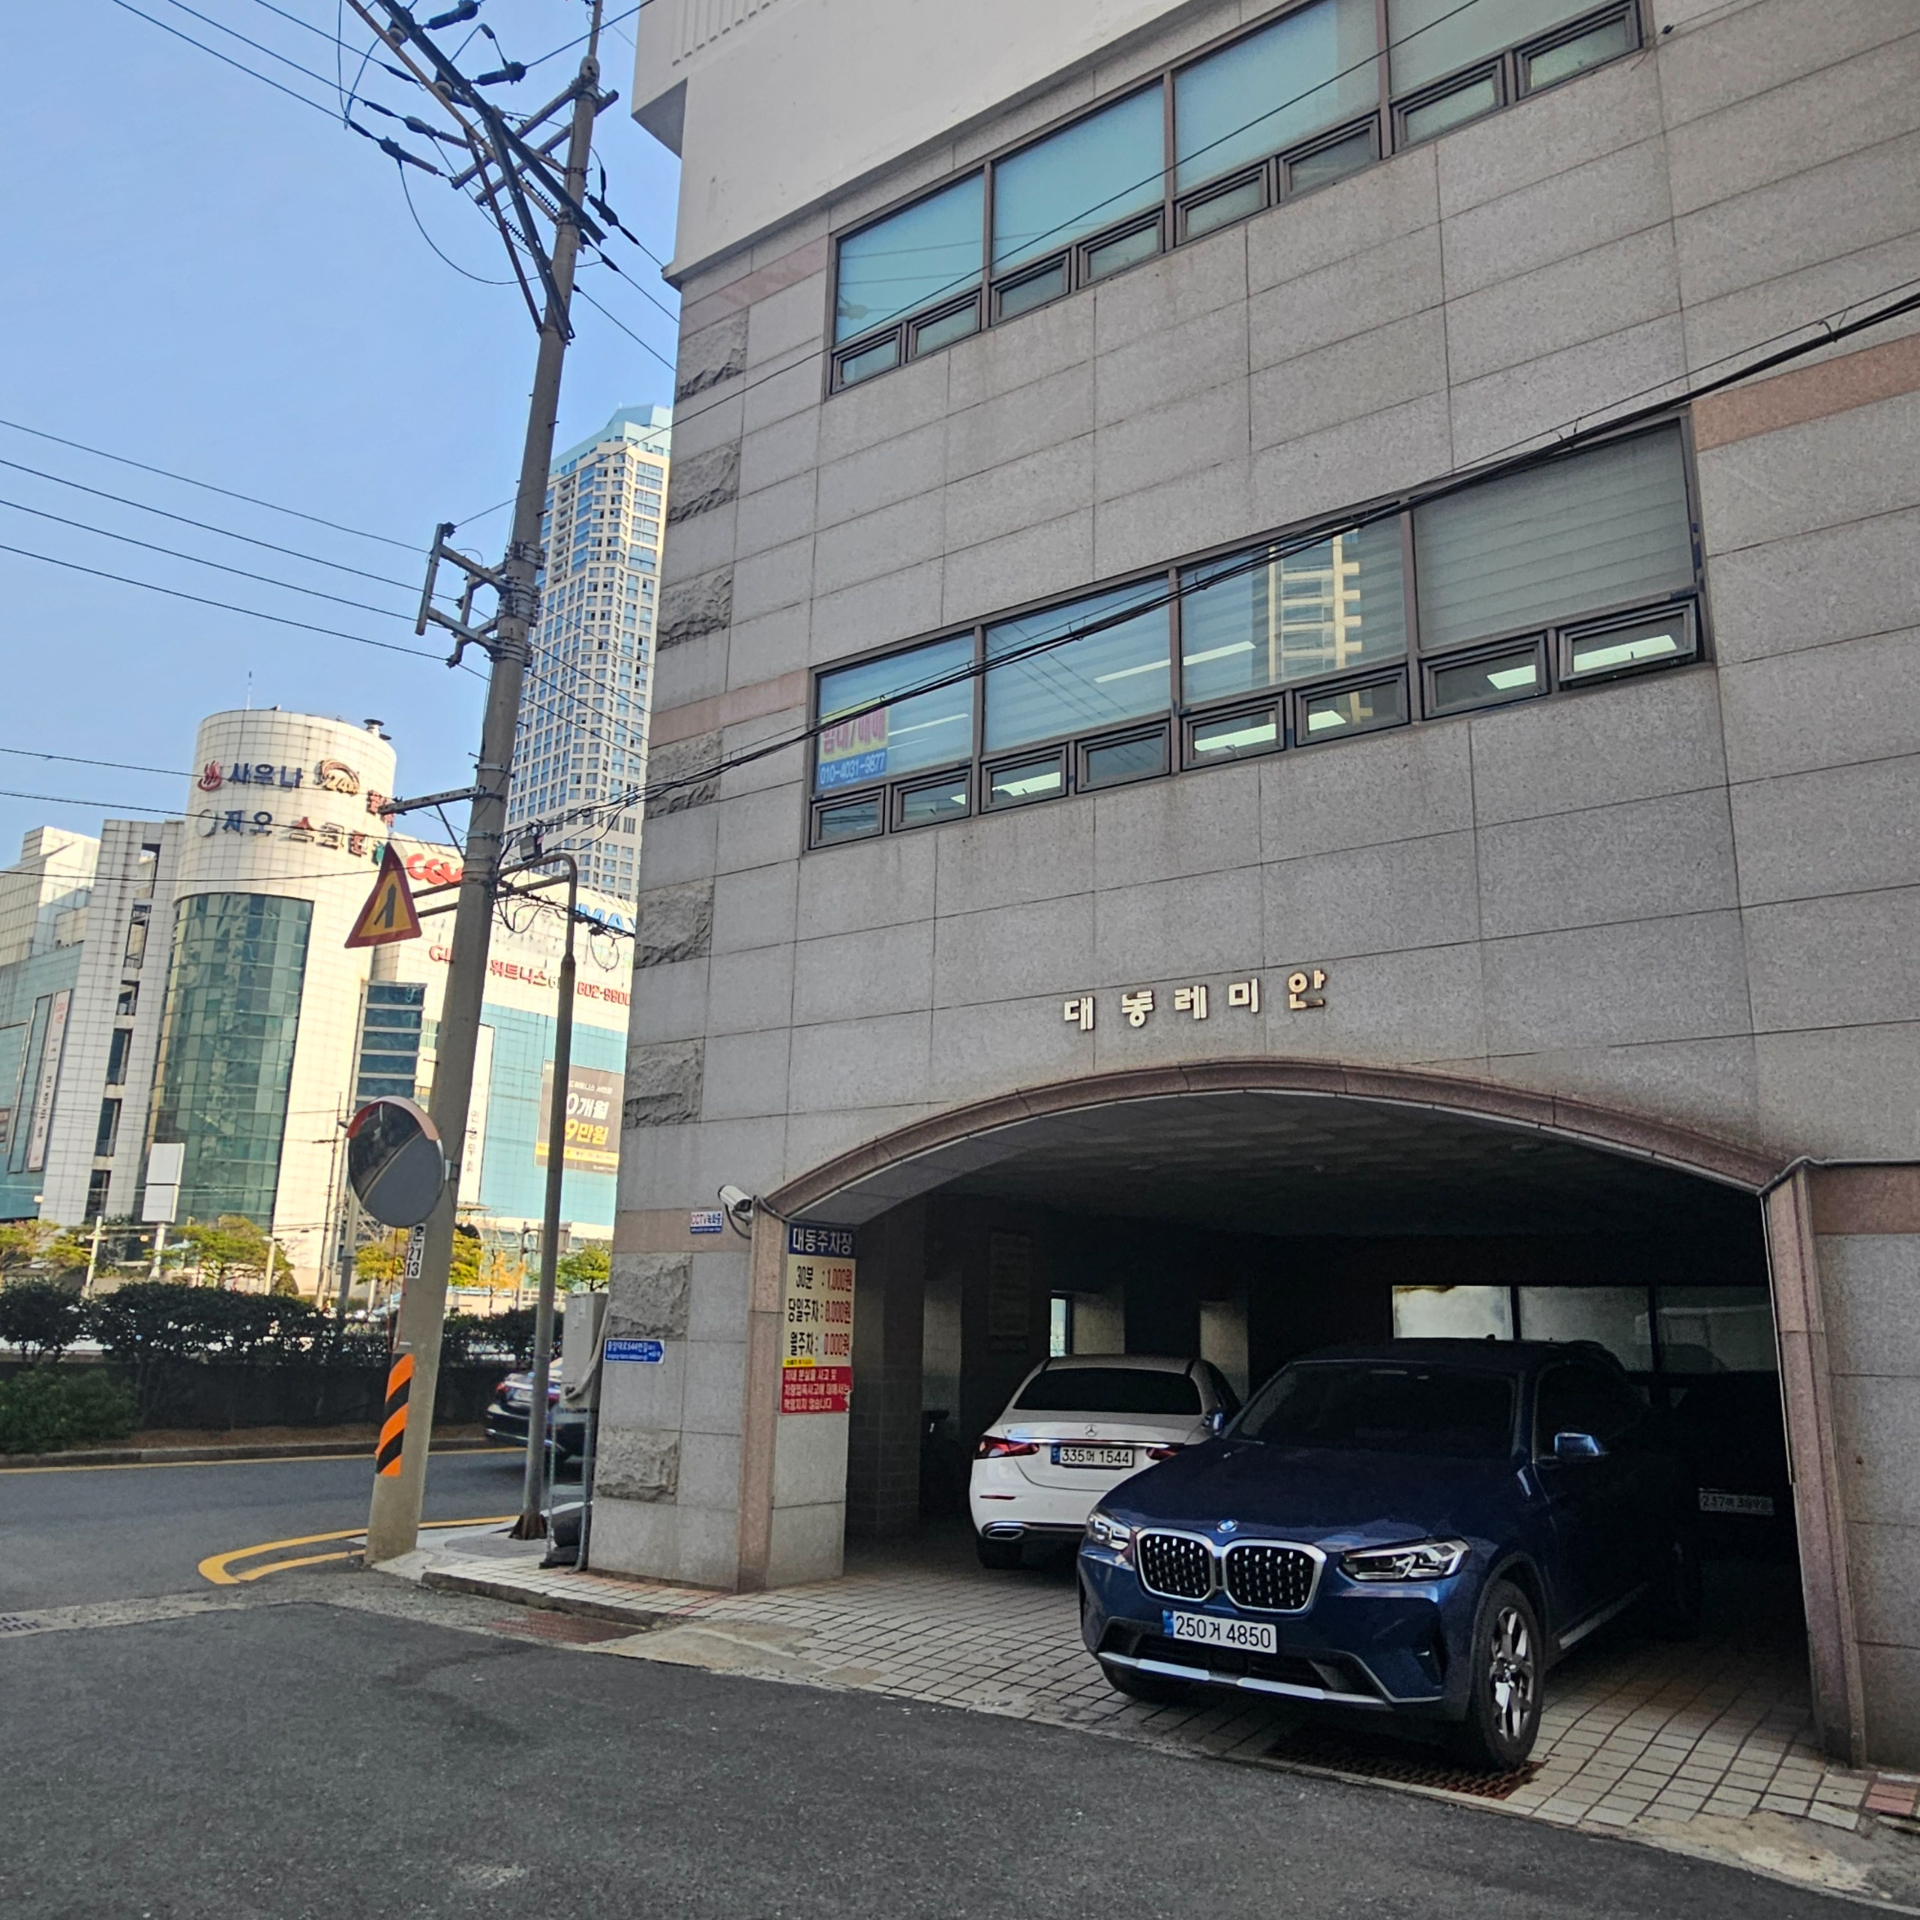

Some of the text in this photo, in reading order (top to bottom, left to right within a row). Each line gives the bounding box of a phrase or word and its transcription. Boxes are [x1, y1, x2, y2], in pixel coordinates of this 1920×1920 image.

[227, 762, 303, 788] 사우나
[406, 853, 463, 885] CGV
[792, 1228, 853, 1255] 대동주차장
[796, 1265, 814, 1290] 30분
[788, 1298, 819, 1323] 당일주차
[790, 1331, 814, 1356] 월주차
[1099, 1450, 1129, 1464] 1544
[1226, 1623, 1271, 1649] 4850
